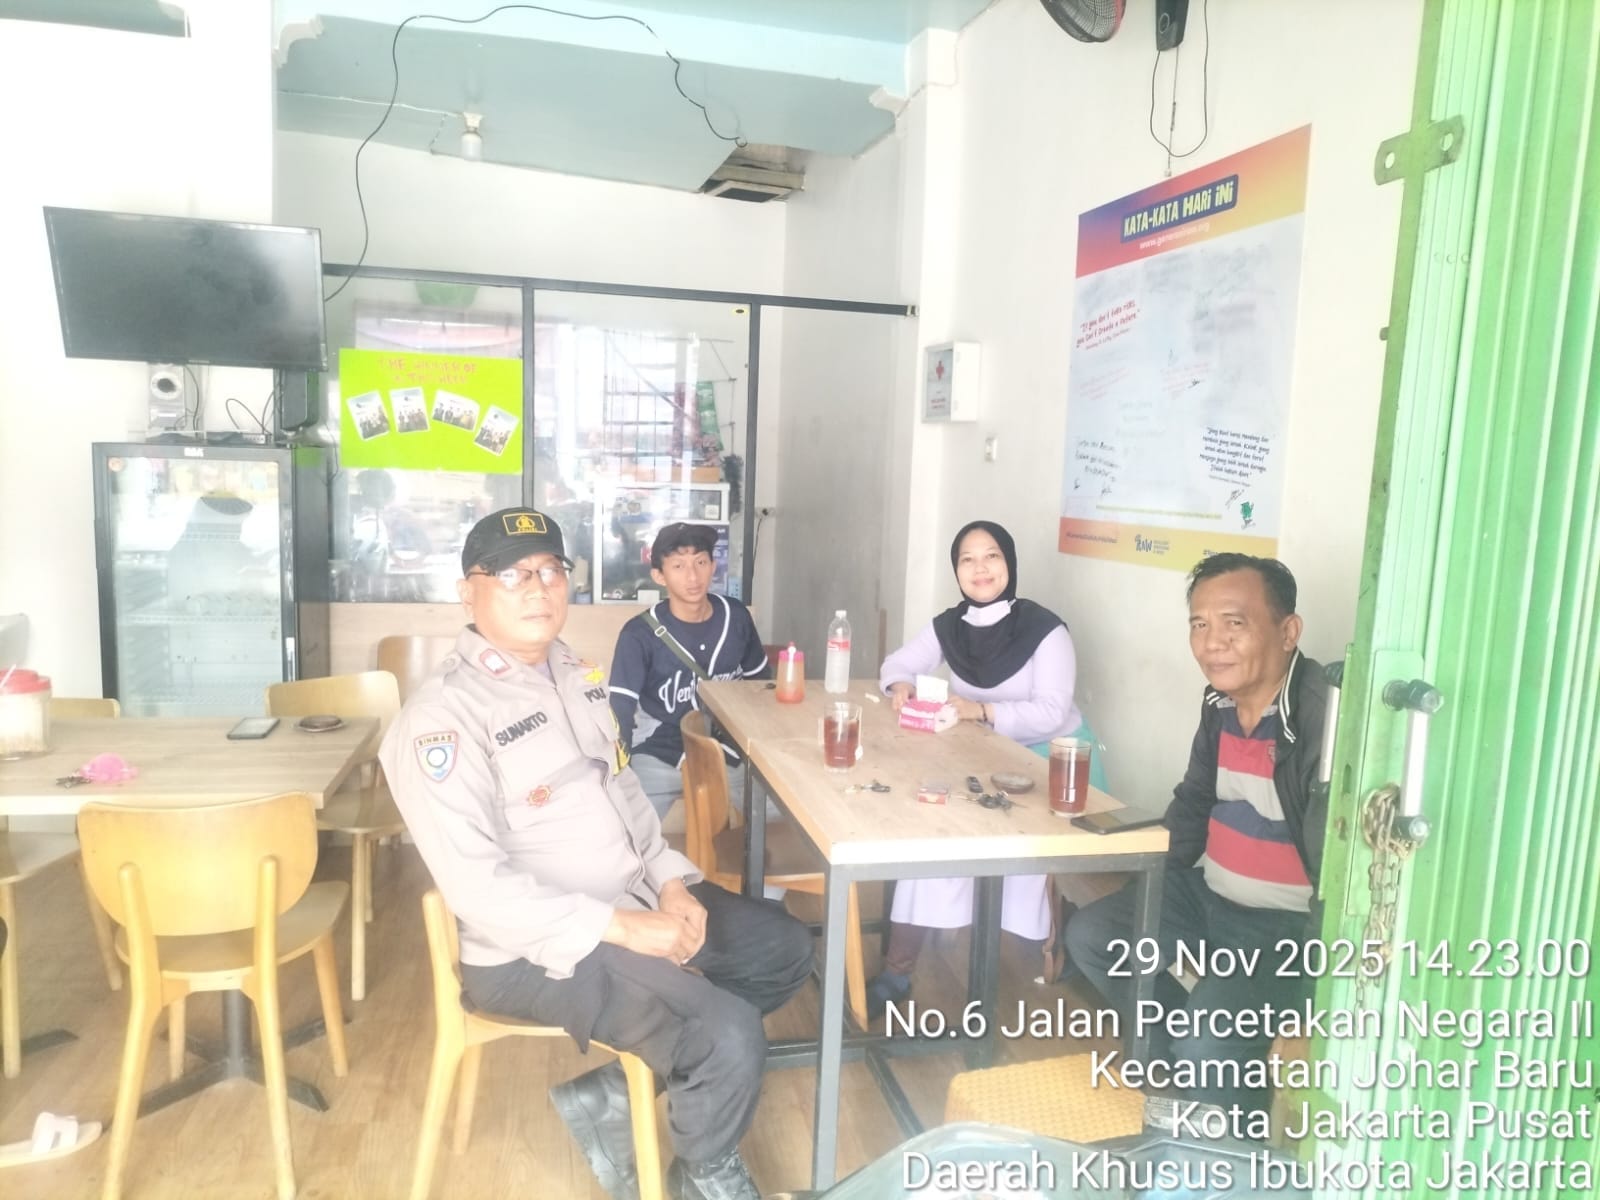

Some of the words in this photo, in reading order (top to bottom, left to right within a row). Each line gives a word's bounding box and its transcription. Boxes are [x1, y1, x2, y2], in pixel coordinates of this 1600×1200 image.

[1124, 201, 1179, 237] KATA-KATA
[418, 735, 452, 746] BINMAS
[495, 711, 548, 746] SUNARTO
